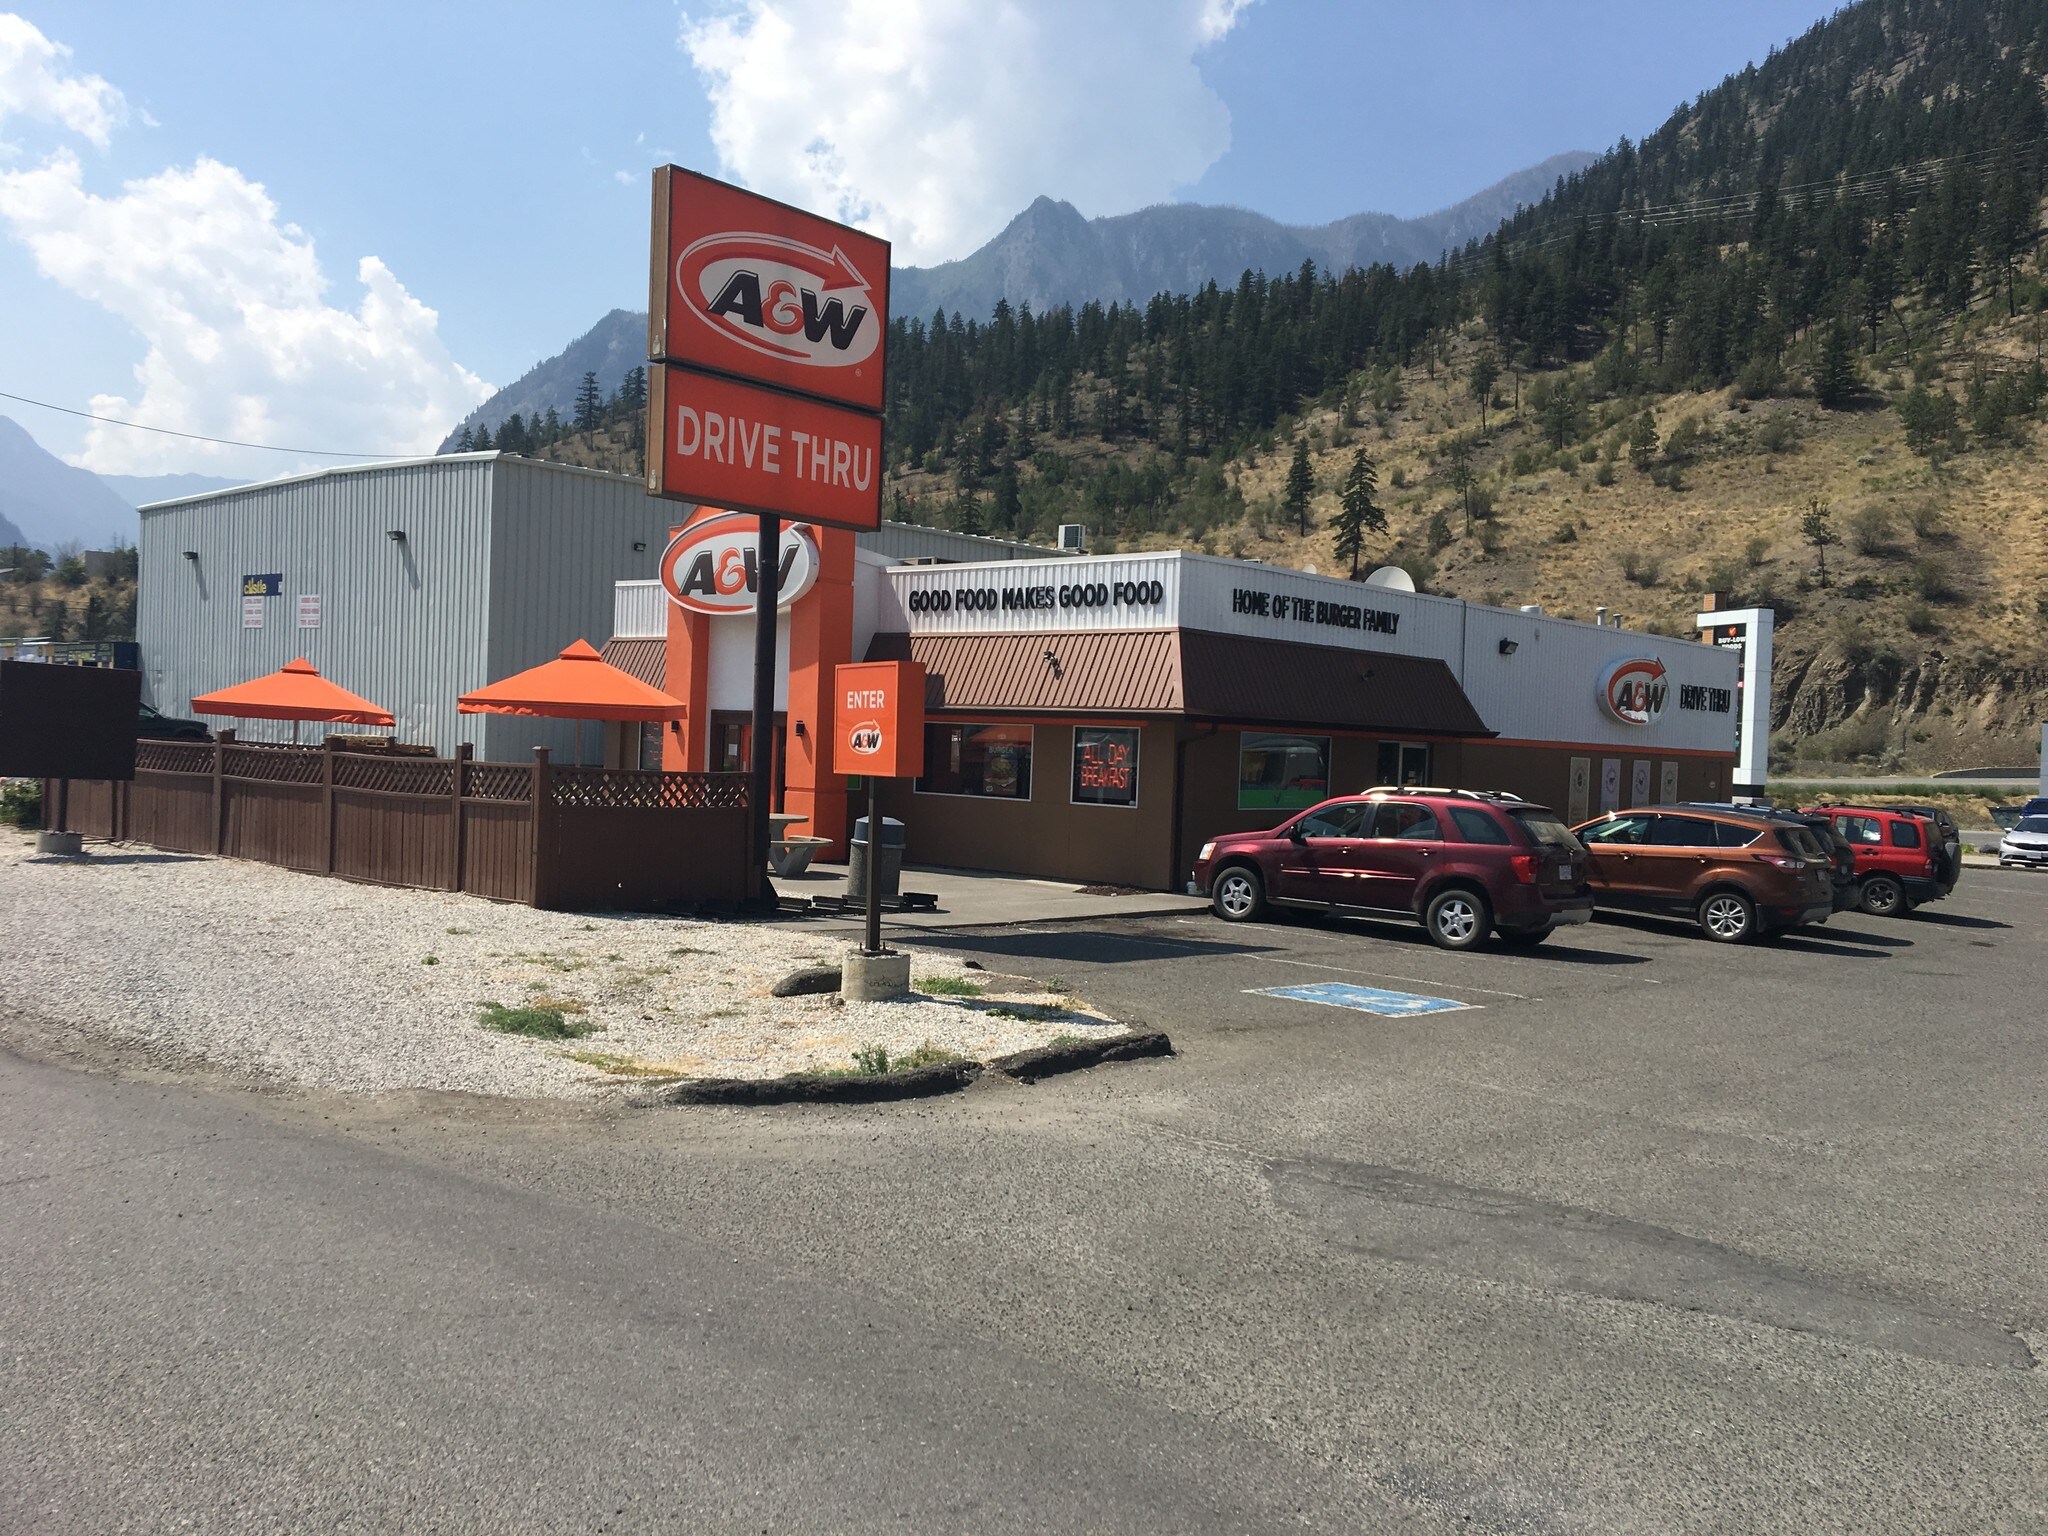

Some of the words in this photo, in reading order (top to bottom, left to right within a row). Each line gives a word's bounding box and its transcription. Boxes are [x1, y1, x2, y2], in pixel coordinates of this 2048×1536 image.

[705, 269, 867, 351] A&W
[677, 404, 781, 474] DRIVE
[791, 431, 871, 492] THRU
[678, 544, 800, 596] A&W
[908, 589, 951, 612] GOOD
[955, 588, 998, 611] FOOD
[1001, 585, 1055, 610] MAKES
[1058, 582, 1109, 608] GOOD
[1113, 580, 1163, 606] FOOD
[1232, 588, 1270, 616] HOME
[1272, 594, 1290, 619] OF
[1291, 596, 1315, 623] THE
[1316, 601, 1362, 630] BURGER
[1363, 608, 1400, 635] FAMILY
[847, 690, 885, 709] ENTER
[1616, 680, 1667, 713] A&W
[1680, 684, 1708, 711] DRIVE
[1709, 687, 1731, 713] THRU
[853, 733, 880, 749] A&W
[1083, 744, 1104, 765] ALL
[1107, 743, 1130, 765] DAY
[1081, 766, 1130, 789] BREAKFAST
